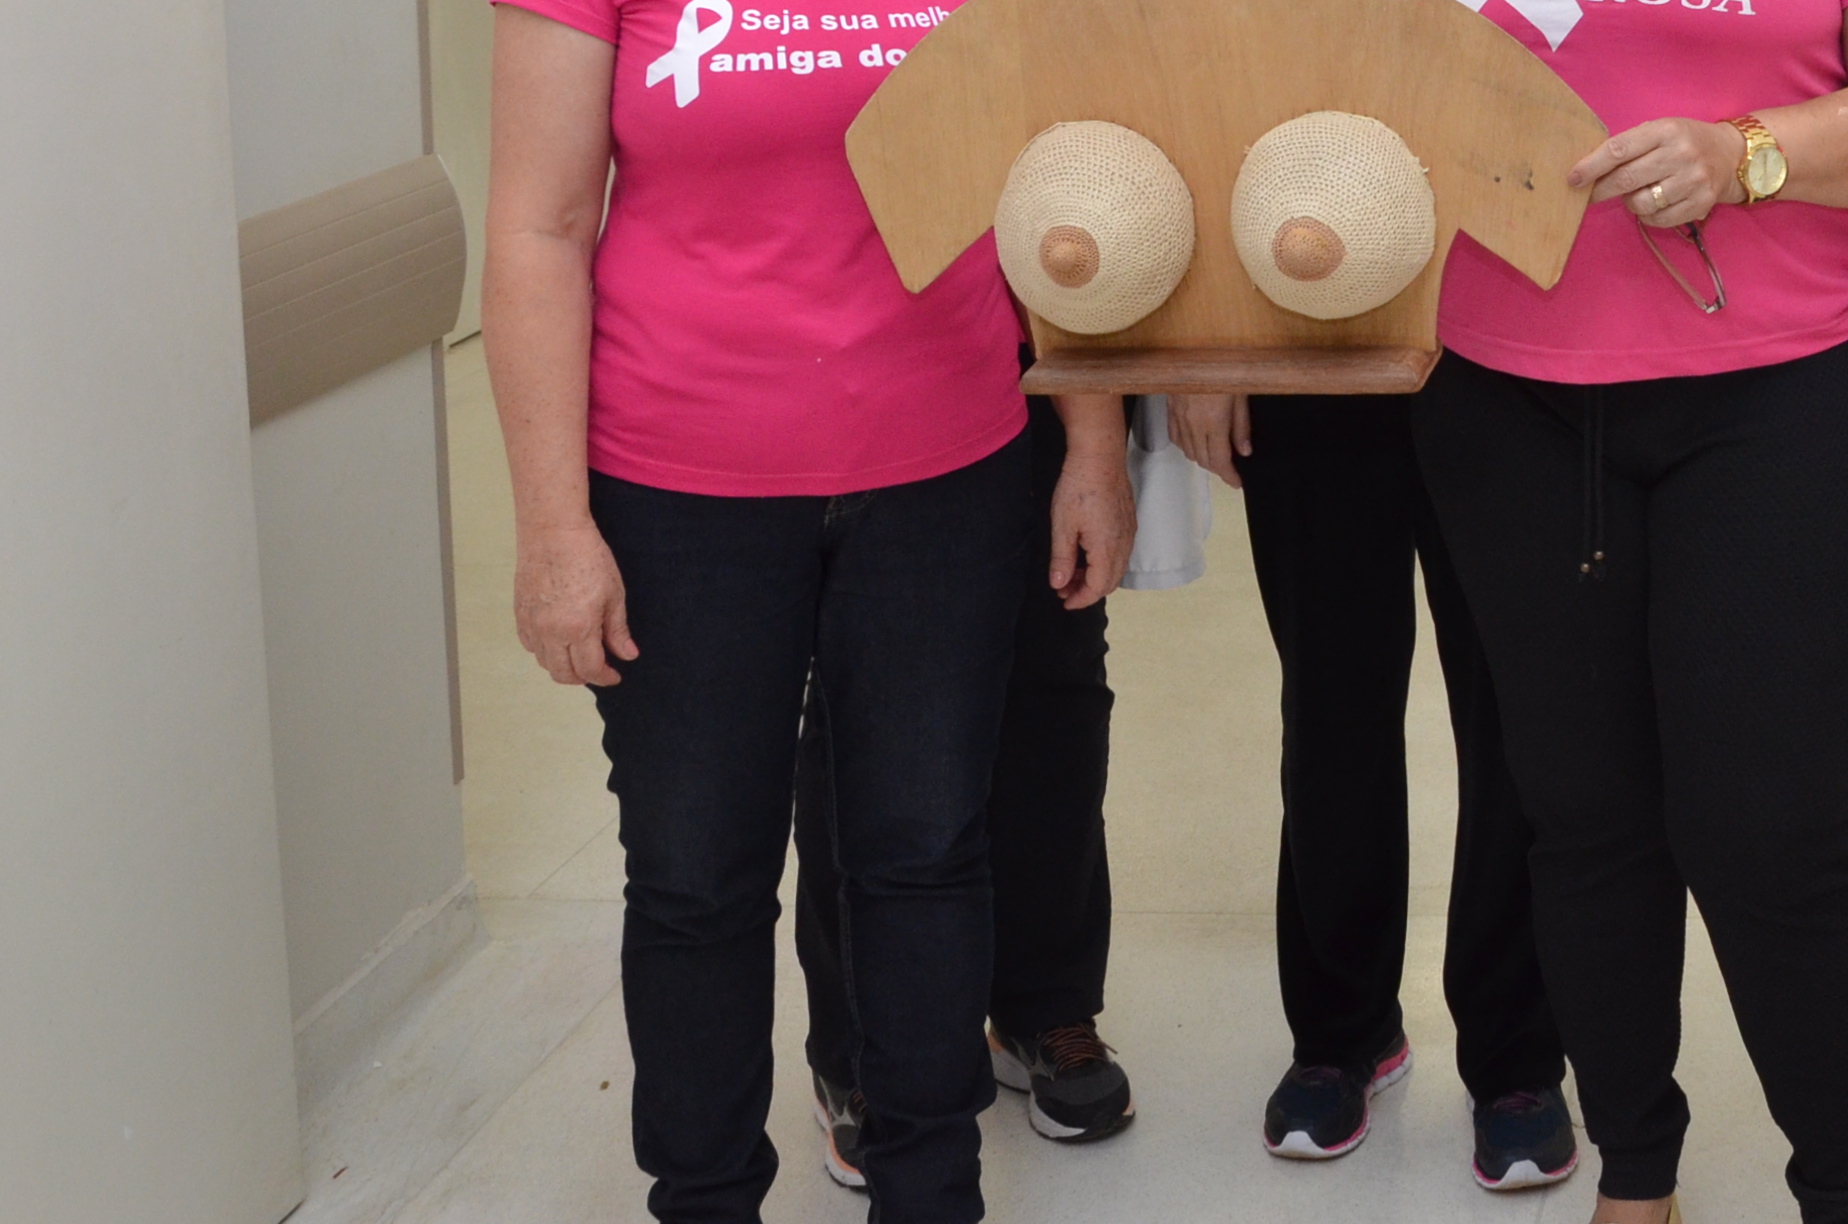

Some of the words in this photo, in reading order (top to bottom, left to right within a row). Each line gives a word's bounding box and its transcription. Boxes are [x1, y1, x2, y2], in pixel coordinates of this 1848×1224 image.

[741, 9, 809, 34] Seja
[821, 15, 879, 30] sua
[710, 46, 842, 75] amiga
[858, 44, 908, 67] do
